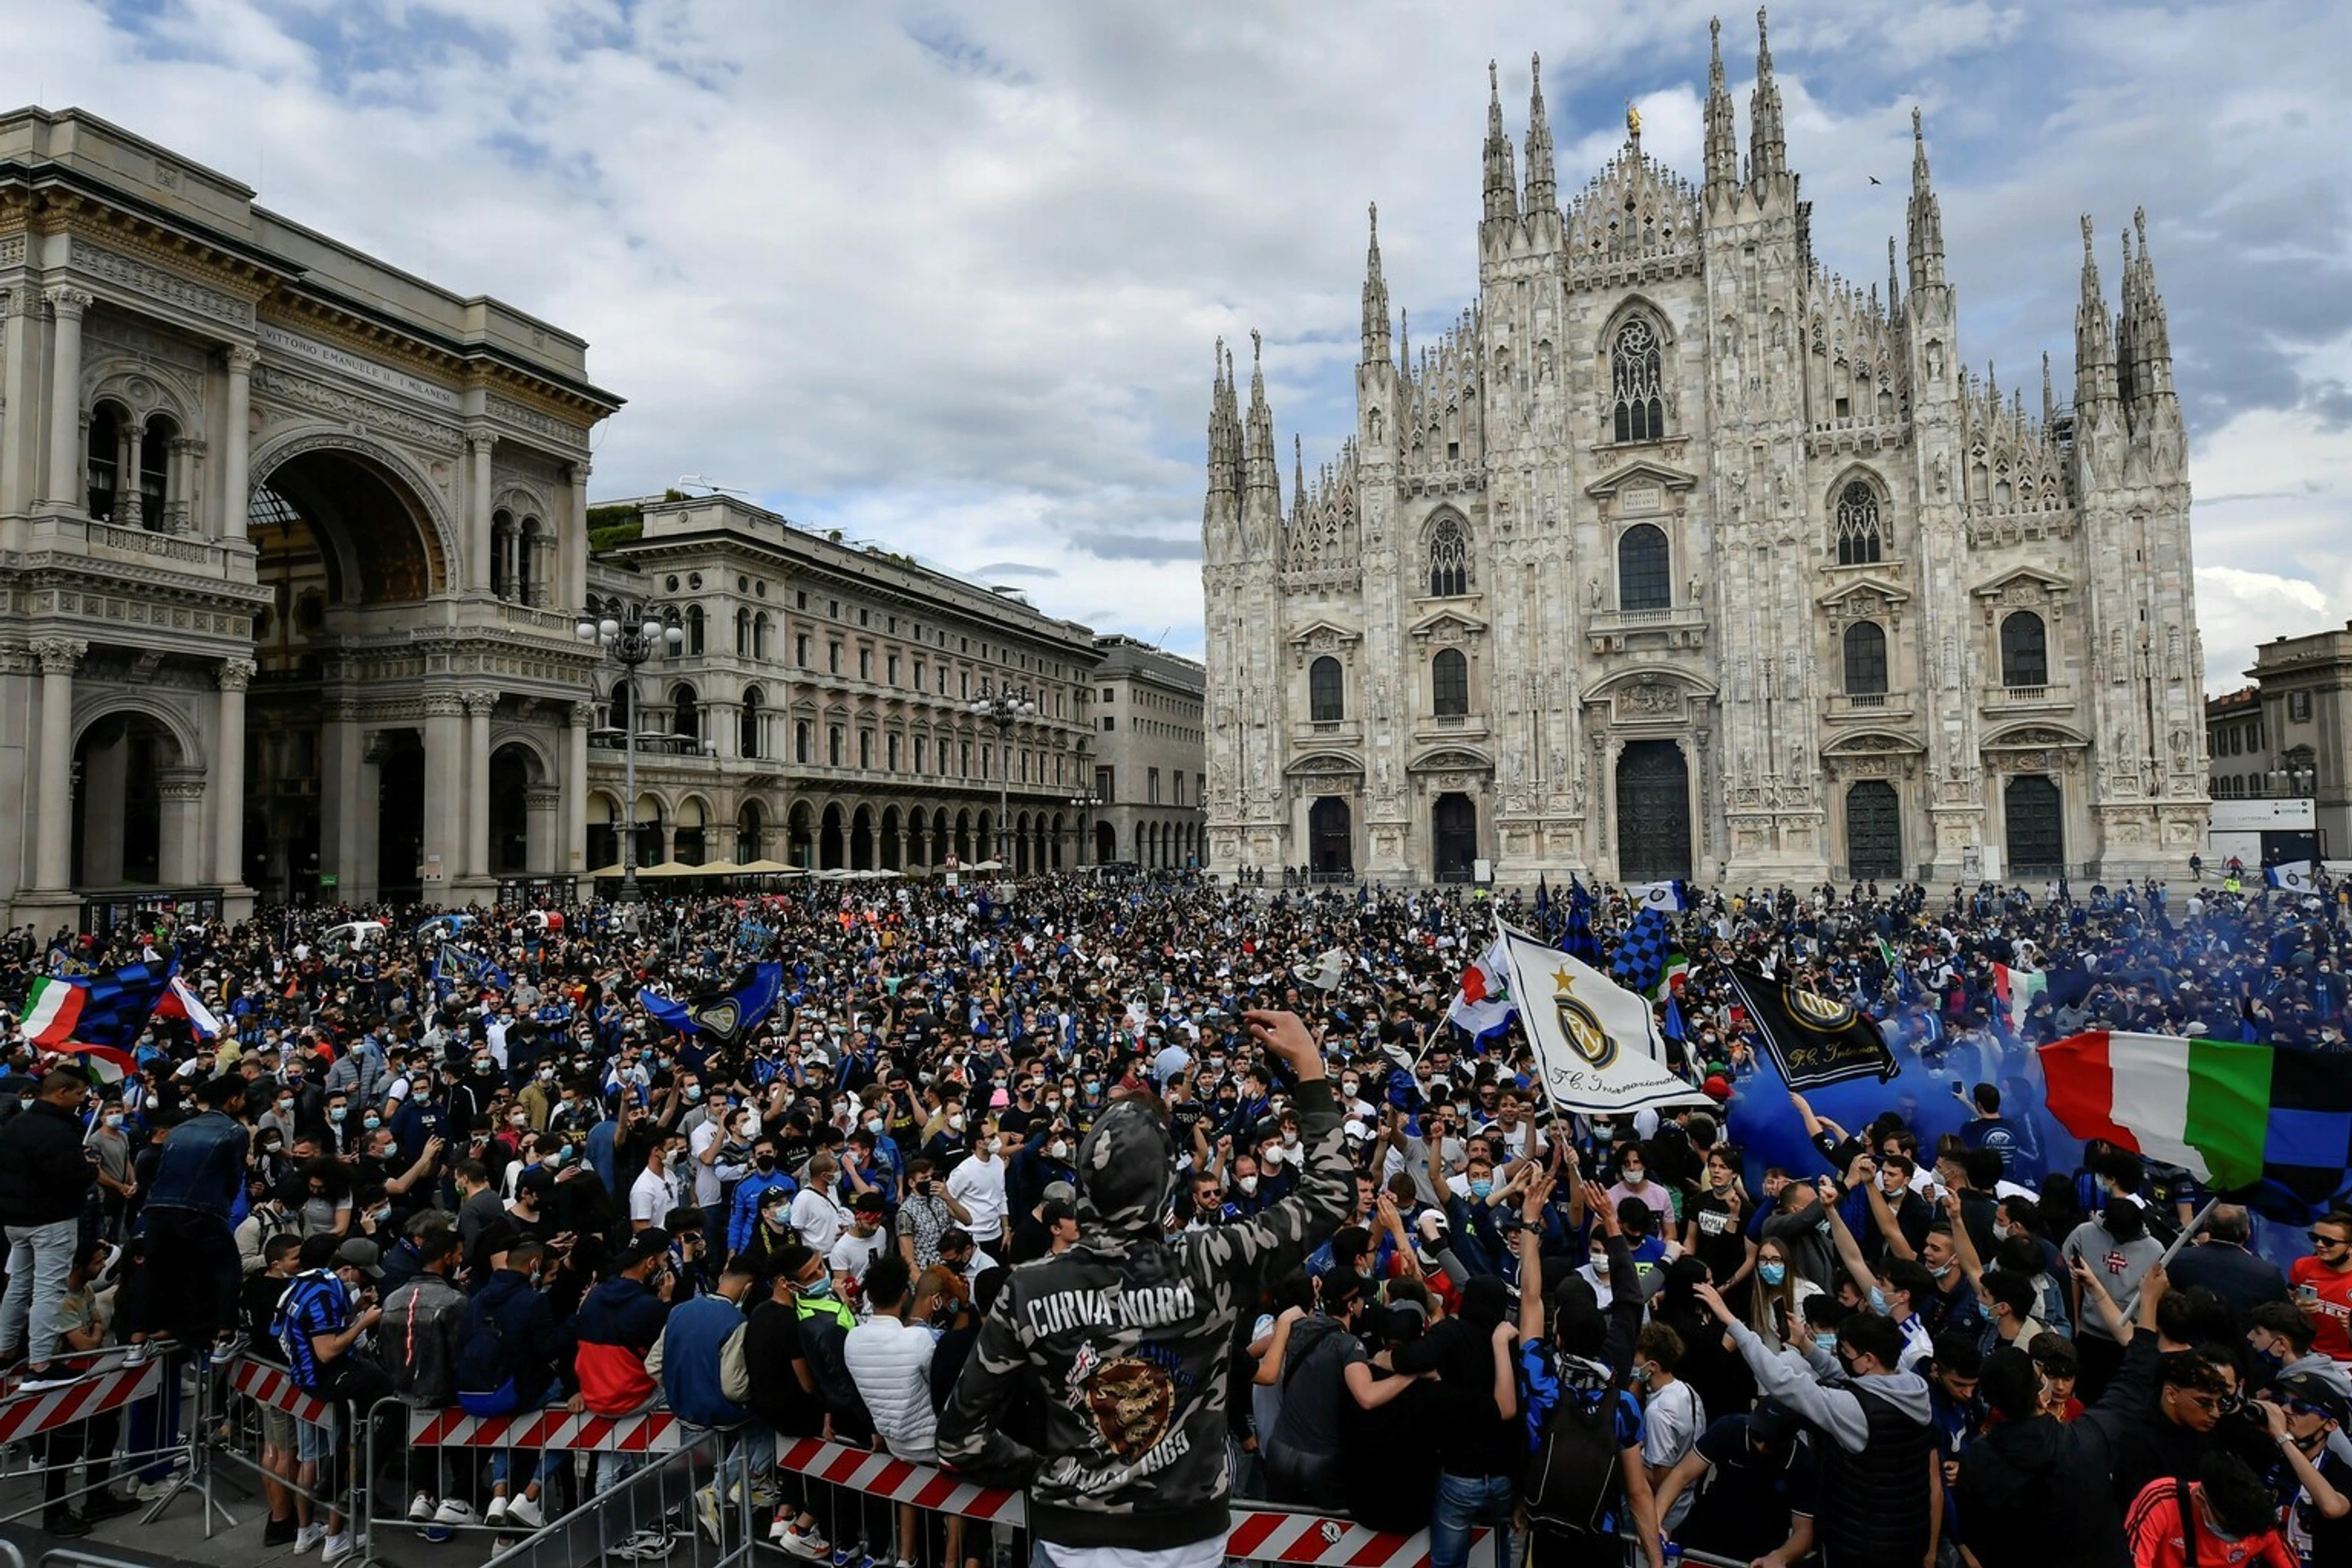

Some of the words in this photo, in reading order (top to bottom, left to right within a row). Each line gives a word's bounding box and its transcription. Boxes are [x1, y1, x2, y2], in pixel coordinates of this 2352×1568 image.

[266, 329, 317, 354] VITTORIO
[323, 350, 378, 378] EMANUELE
[408, 381, 450, 403] MILANESI
[946, 857, 957, 866] M
[1027, 1290, 1113, 1338] CURVA
[1118, 1285, 1196, 1330] NORD
[1140, 1429, 1191, 1477] 1969
